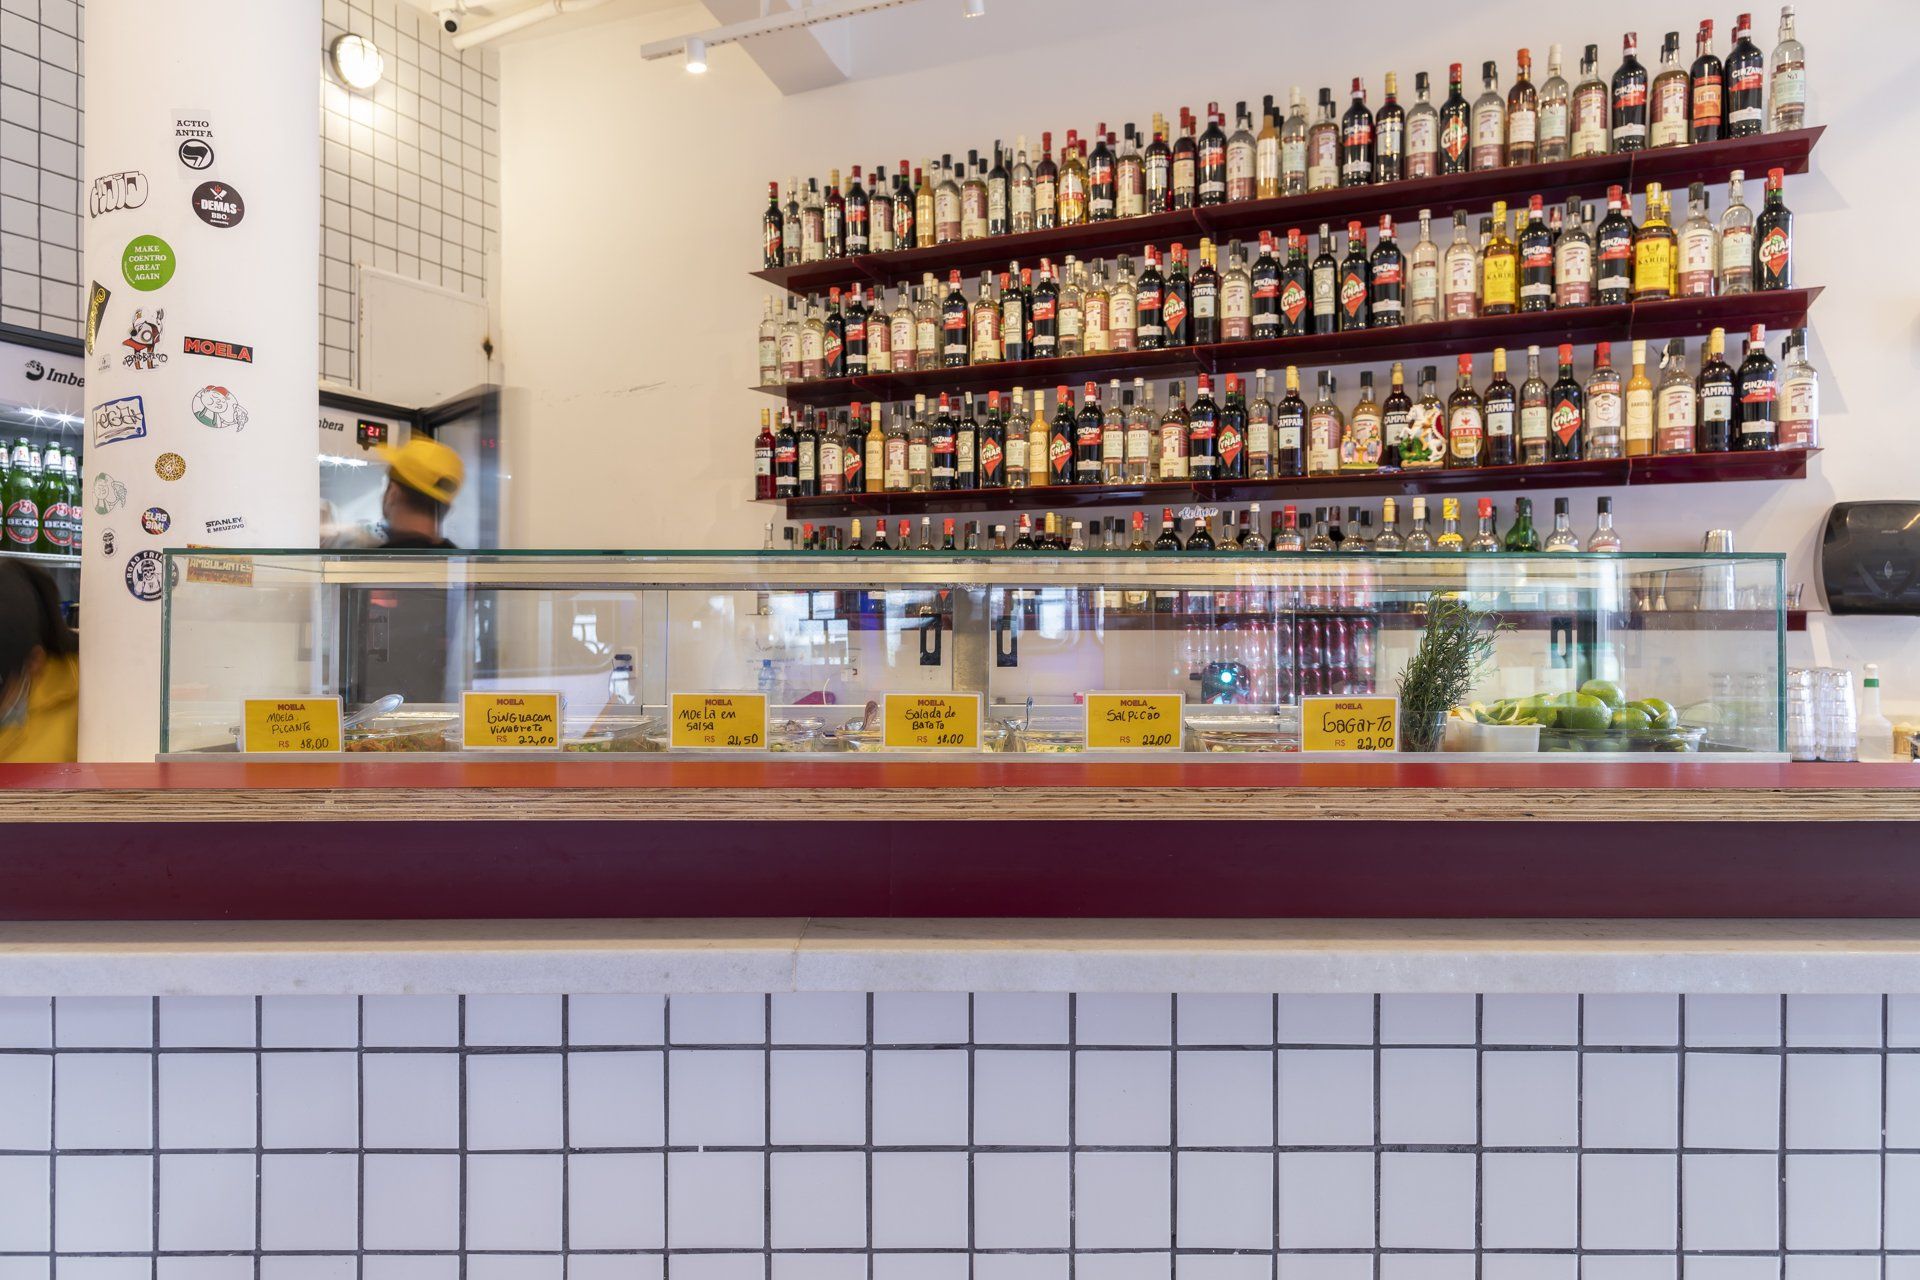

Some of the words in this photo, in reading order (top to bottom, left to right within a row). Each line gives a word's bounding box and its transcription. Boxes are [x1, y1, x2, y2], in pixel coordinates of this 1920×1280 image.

[176, 119, 210, 128] ACTIO
[175, 129, 214, 138] ANTIFA
[201, 199, 238, 215] DEMAS
[1600, 237, 1630, 248] CINZANO
[134, 245, 160, 253] MAKE
[1522, 246, 1551, 256] CINZANO
[128, 254, 167, 263] COENTRO
[1372, 263, 1399, 273] CINZANO
[1254, 278, 1279, 287] CINZANO
[1281, 290, 1305, 311] CYNAR
[184, 338, 252, 362] MOELA
[1743, 380, 1776, 391] CINZANO
[1701, 386, 1734, 397] CAMPARI
[1485, 402, 1515, 413] CAMPARI
[1190, 420, 1214, 429] CINZANO
[1551, 409, 1579, 432] CYNAR
[367, 426, 380, 437] 21
[1077, 427, 1099, 435] CINZANO
[1218, 434, 1242, 454] CYNAR
[981, 446, 1001, 465] CYNAR
[1050, 442, 1071, 460] CYNAR
[145, 512, 168, 521] ELAS
[205, 517, 243, 528] STANLEY
[213, 524, 245, 532] MEUZOVO
[127, 557, 140, 578] ROAD
[188, 559, 252, 573] AMBULANTES
[905, 707, 941, 720] Salada
[945, 706, 956, 718] de
[300, 738, 329, 749] 18,00
[519, 736, 554, 745] 22,00
[728, 733, 758, 746] 21,50
[1142, 734, 1172, 746] 22,00
[1357, 737, 1394, 751] 22,00
